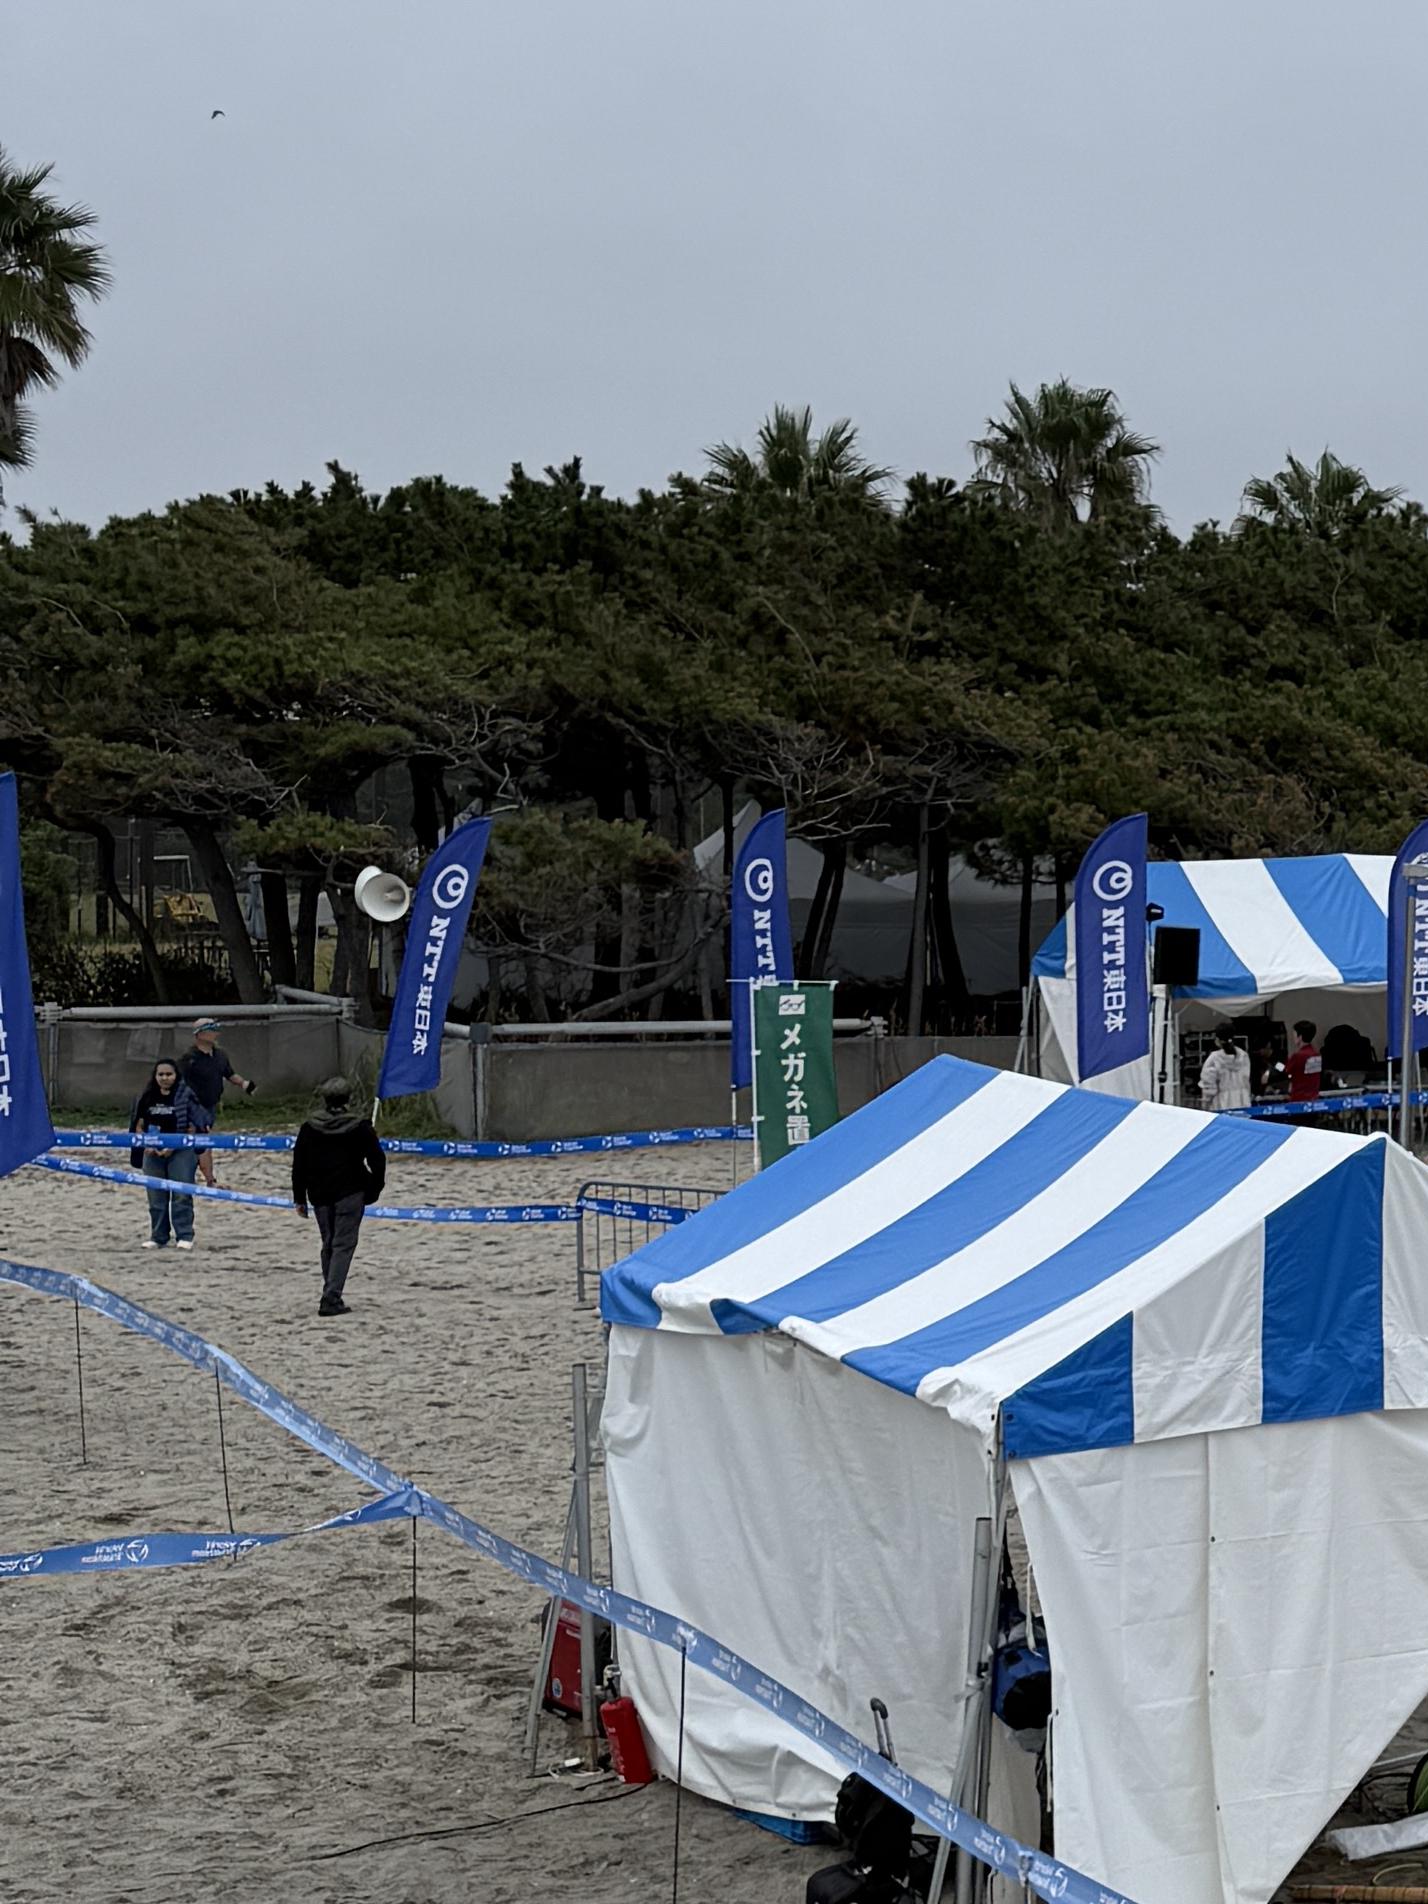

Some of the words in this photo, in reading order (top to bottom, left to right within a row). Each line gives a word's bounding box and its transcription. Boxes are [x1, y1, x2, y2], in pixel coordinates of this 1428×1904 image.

[412, 915, 451, 1056] NTT東日本
[1102, 906, 1127, 1033] NTT東日本
